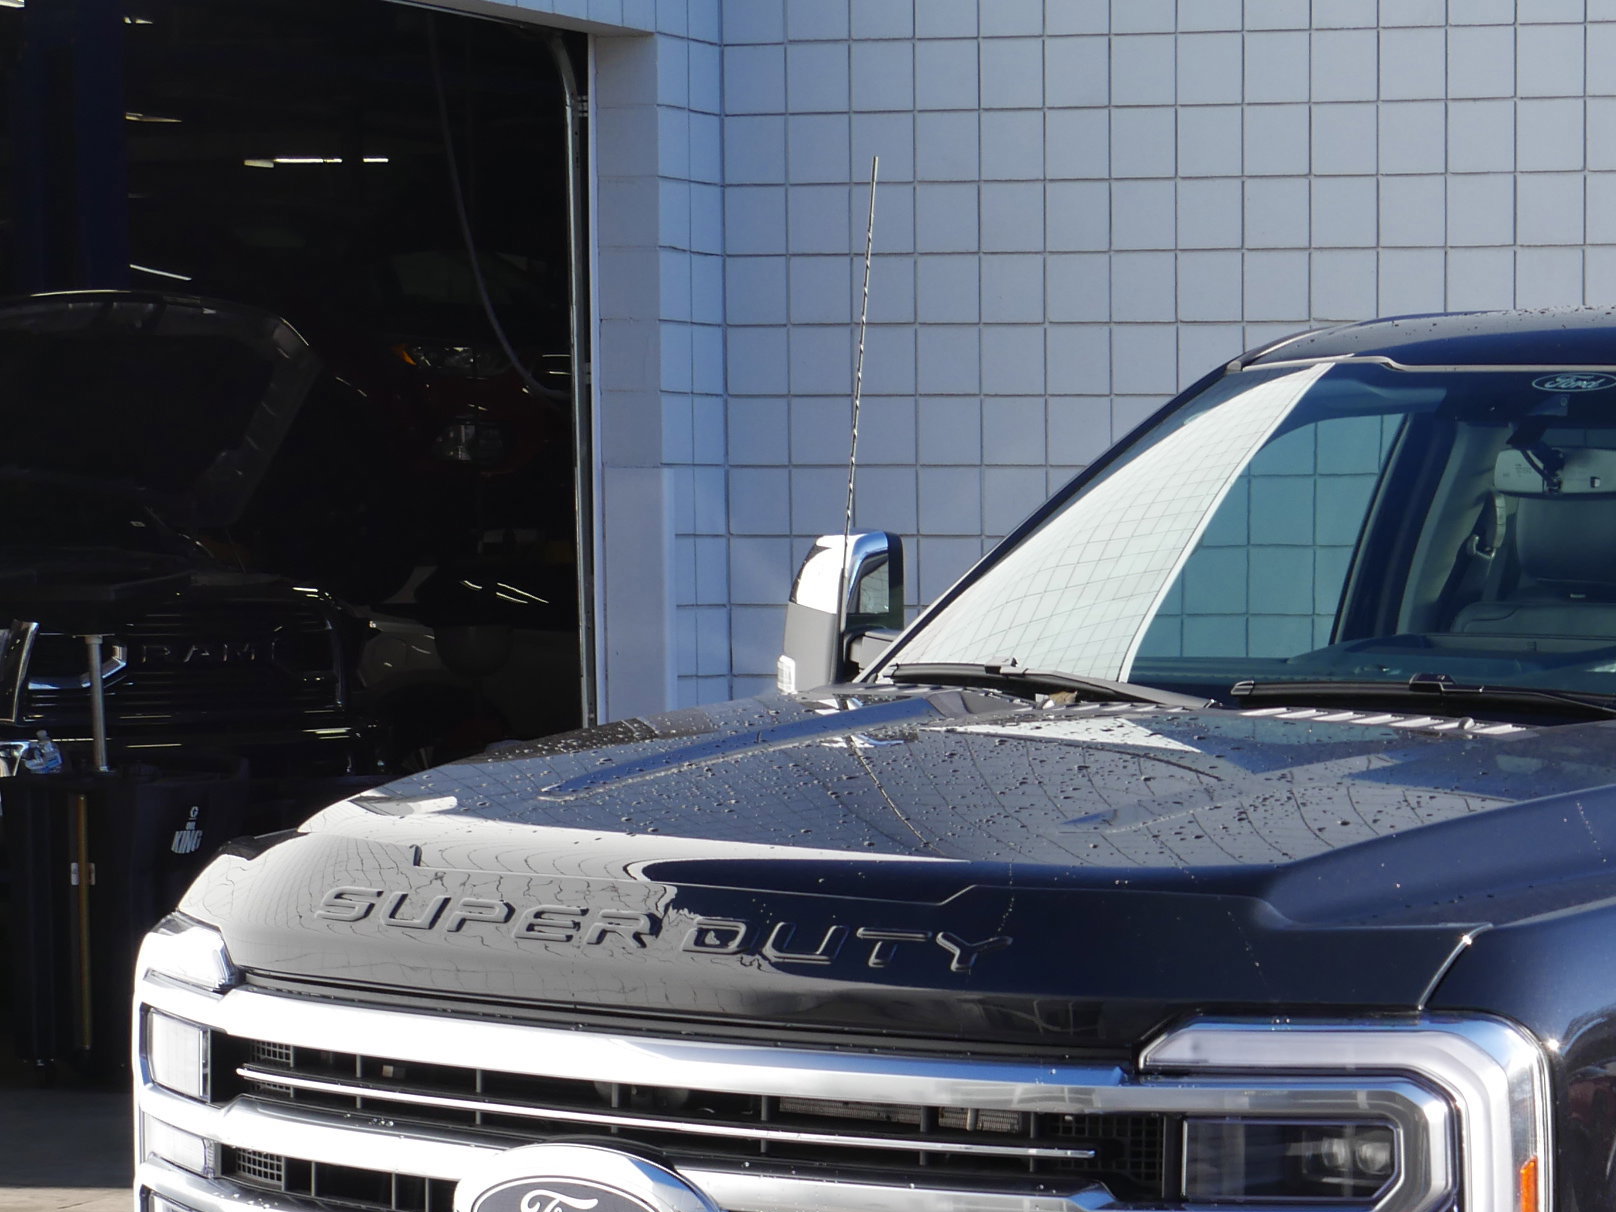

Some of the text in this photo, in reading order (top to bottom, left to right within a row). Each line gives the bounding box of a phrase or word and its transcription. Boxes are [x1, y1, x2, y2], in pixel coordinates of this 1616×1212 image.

[141, 643, 257, 664] RAM
[171, 830, 203, 854] KING
[315, 886, 1013, 972] SUPER DUTY
